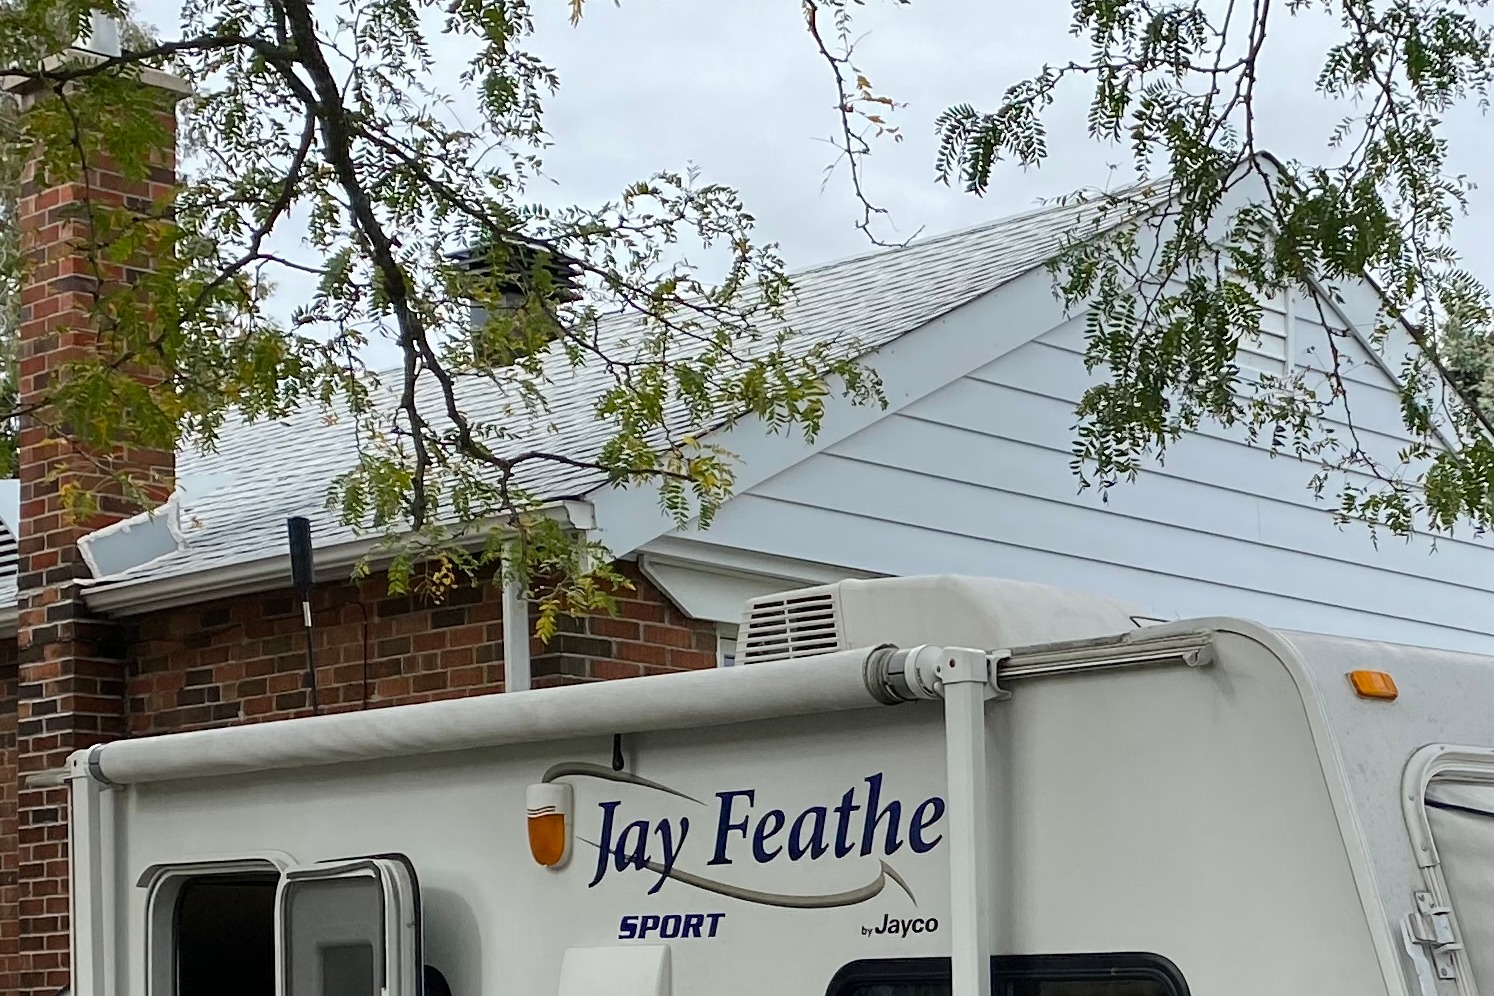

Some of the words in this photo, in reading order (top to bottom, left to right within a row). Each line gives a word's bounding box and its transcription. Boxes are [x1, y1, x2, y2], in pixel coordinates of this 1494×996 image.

[587, 800, 690, 895] Jay
[706, 772, 946, 866] Feathe
[618, 912, 726, 940] SPORT
[860, 924, 874, 938] by
[874, 914, 939, 939] Jayco
